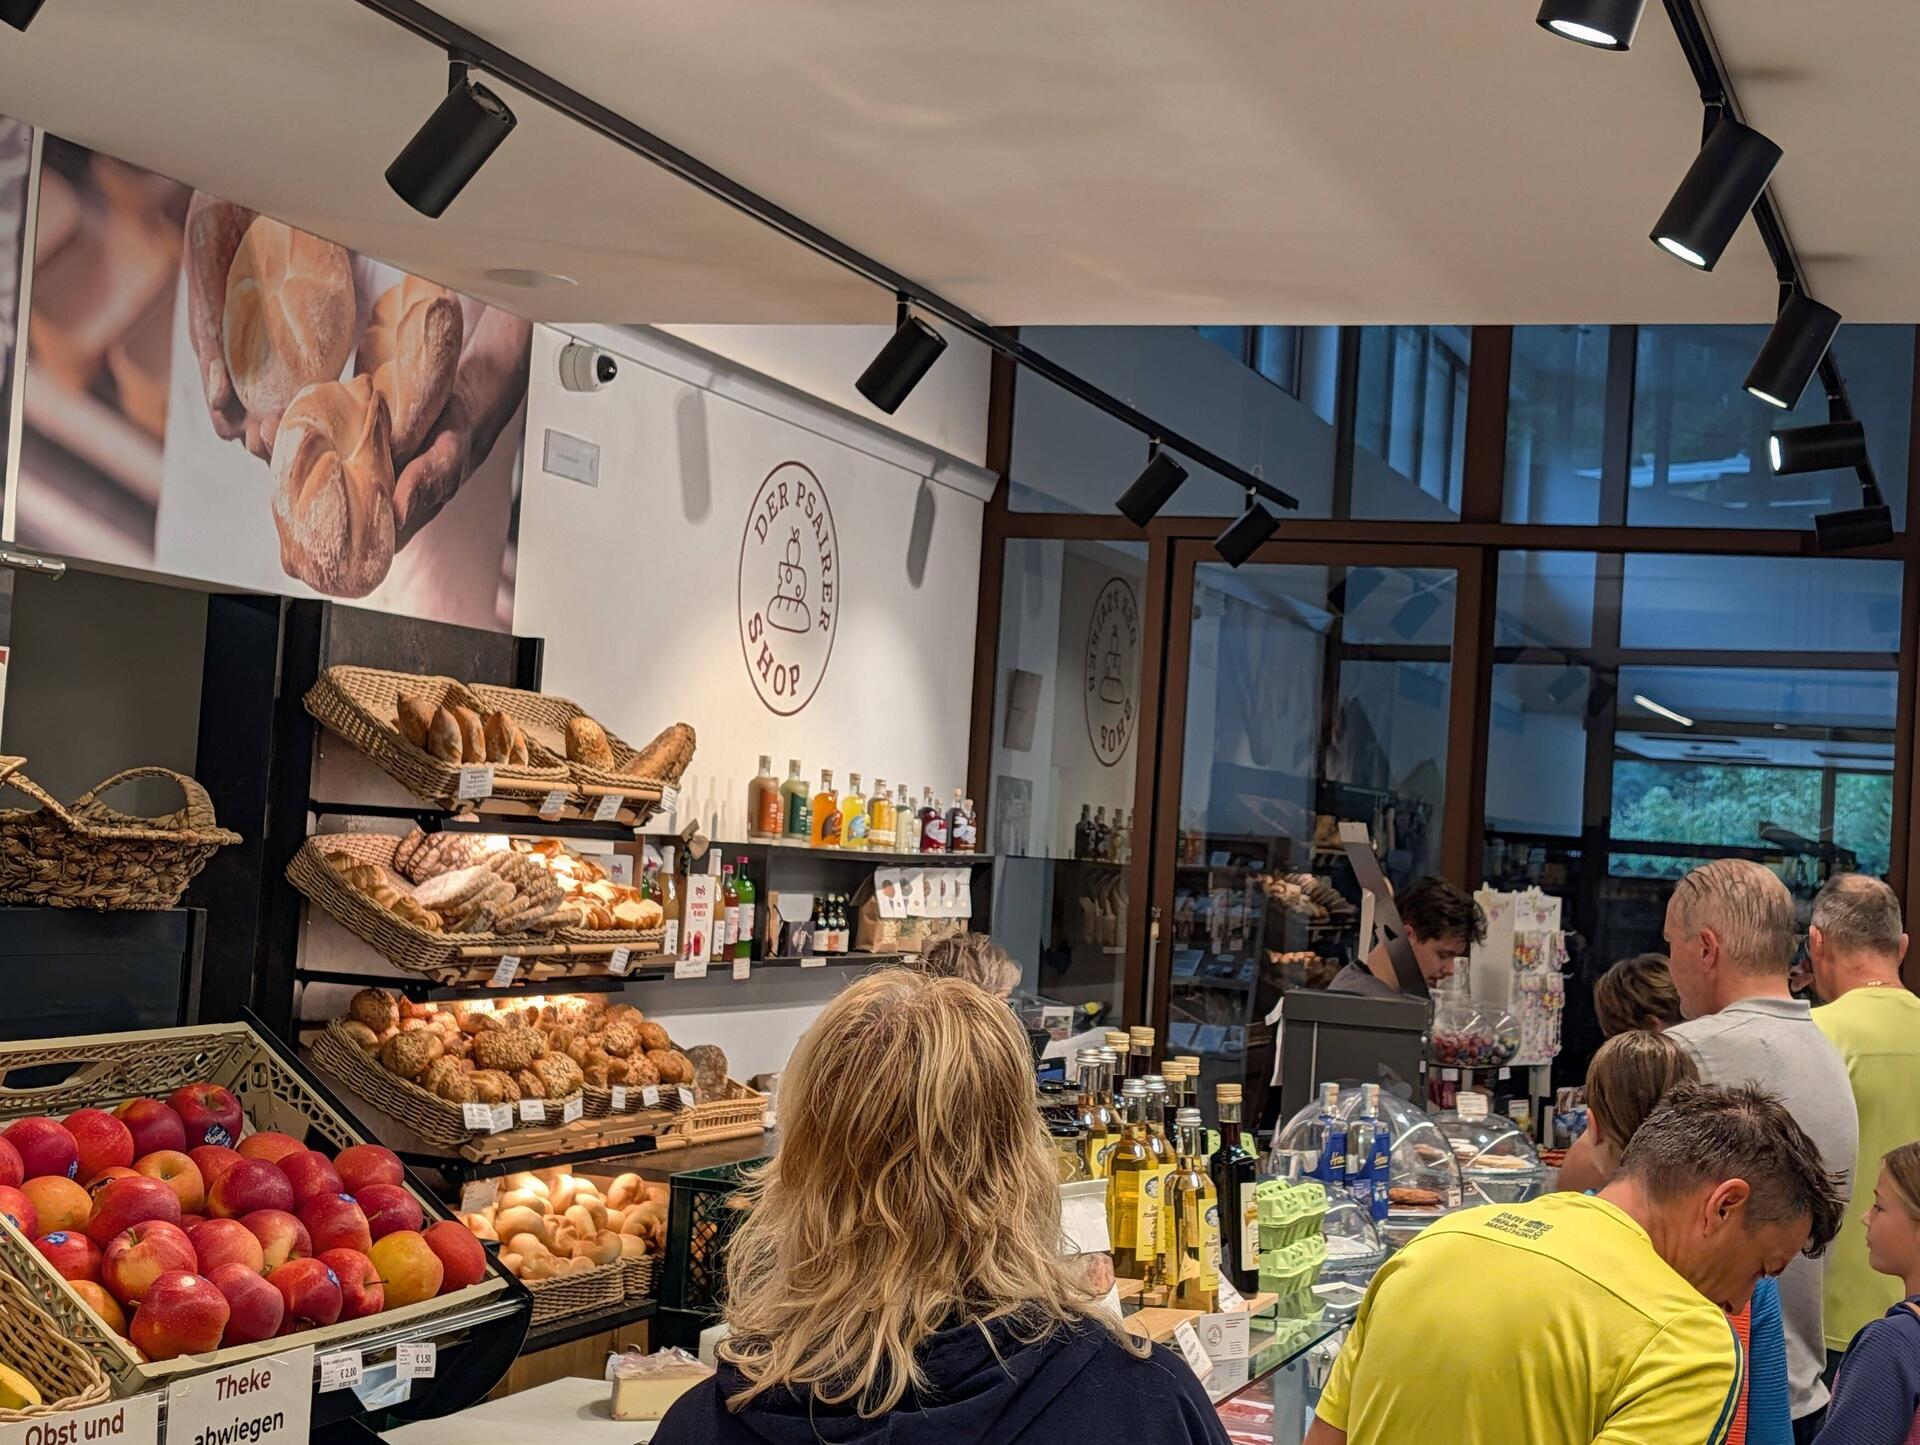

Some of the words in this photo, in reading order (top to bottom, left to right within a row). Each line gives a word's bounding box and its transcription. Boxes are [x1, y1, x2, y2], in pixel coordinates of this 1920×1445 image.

[754, 481, 790, 544] DER
[795, 481, 833, 632] PSAIRER
[748, 612, 800, 697] SHOP
[216, 1368, 271, 1401] Theke
[25, 1419, 77, 1445] Obst
[84, 1407, 124, 1440] und
